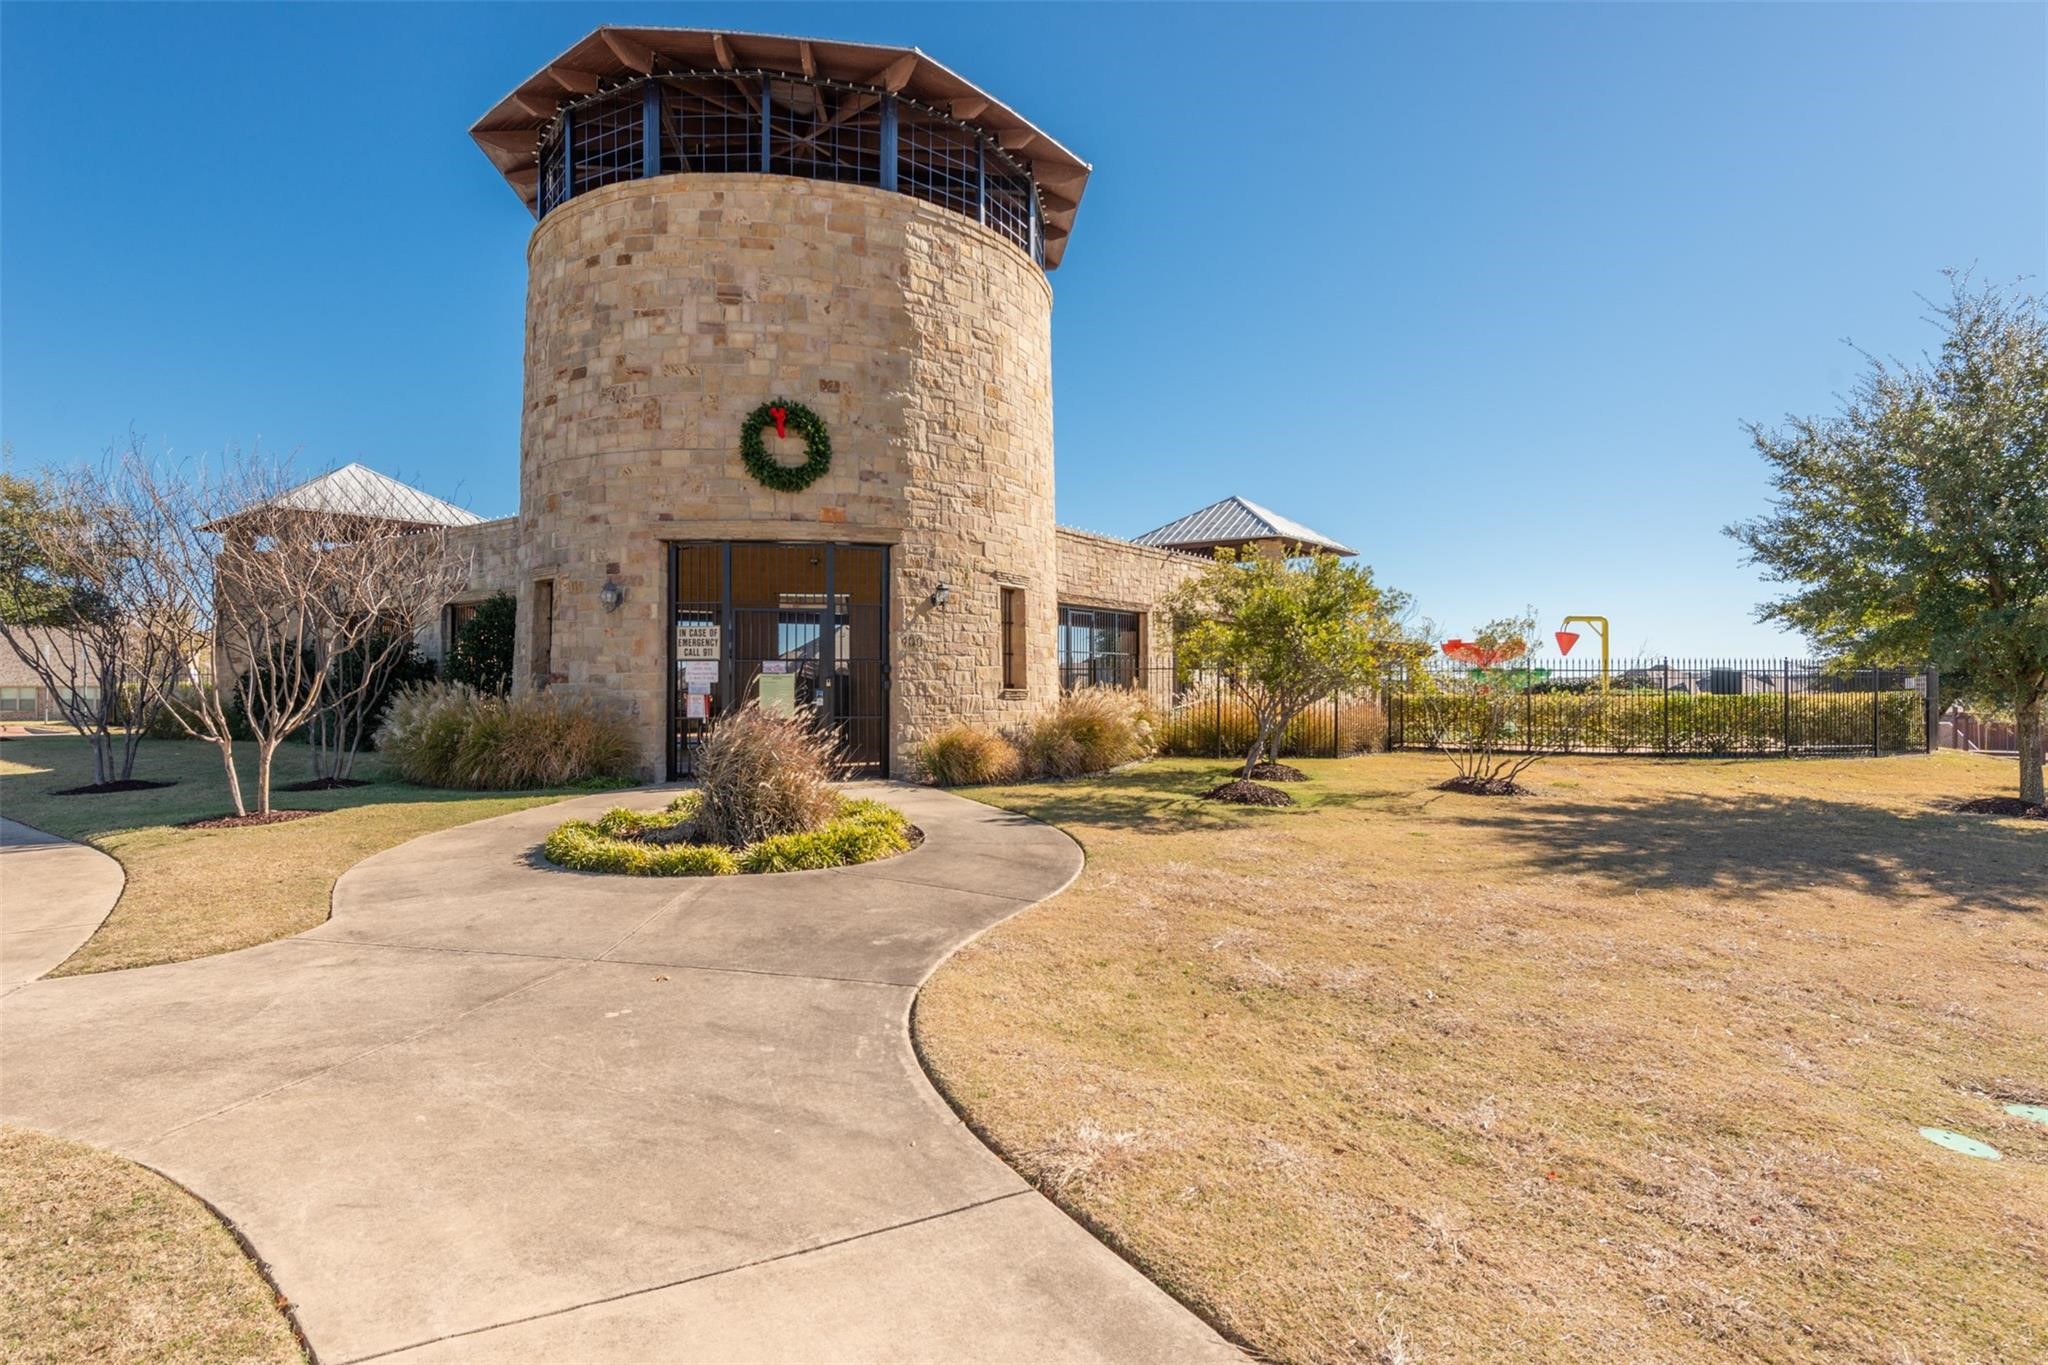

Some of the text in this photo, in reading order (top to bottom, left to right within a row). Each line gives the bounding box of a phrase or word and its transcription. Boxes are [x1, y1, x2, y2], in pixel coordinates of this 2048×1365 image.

[679, 628, 718, 637] IN CASE OF
[678, 638, 719, 647] EMERGENCY
[684, 648, 713, 657] CALL 911
